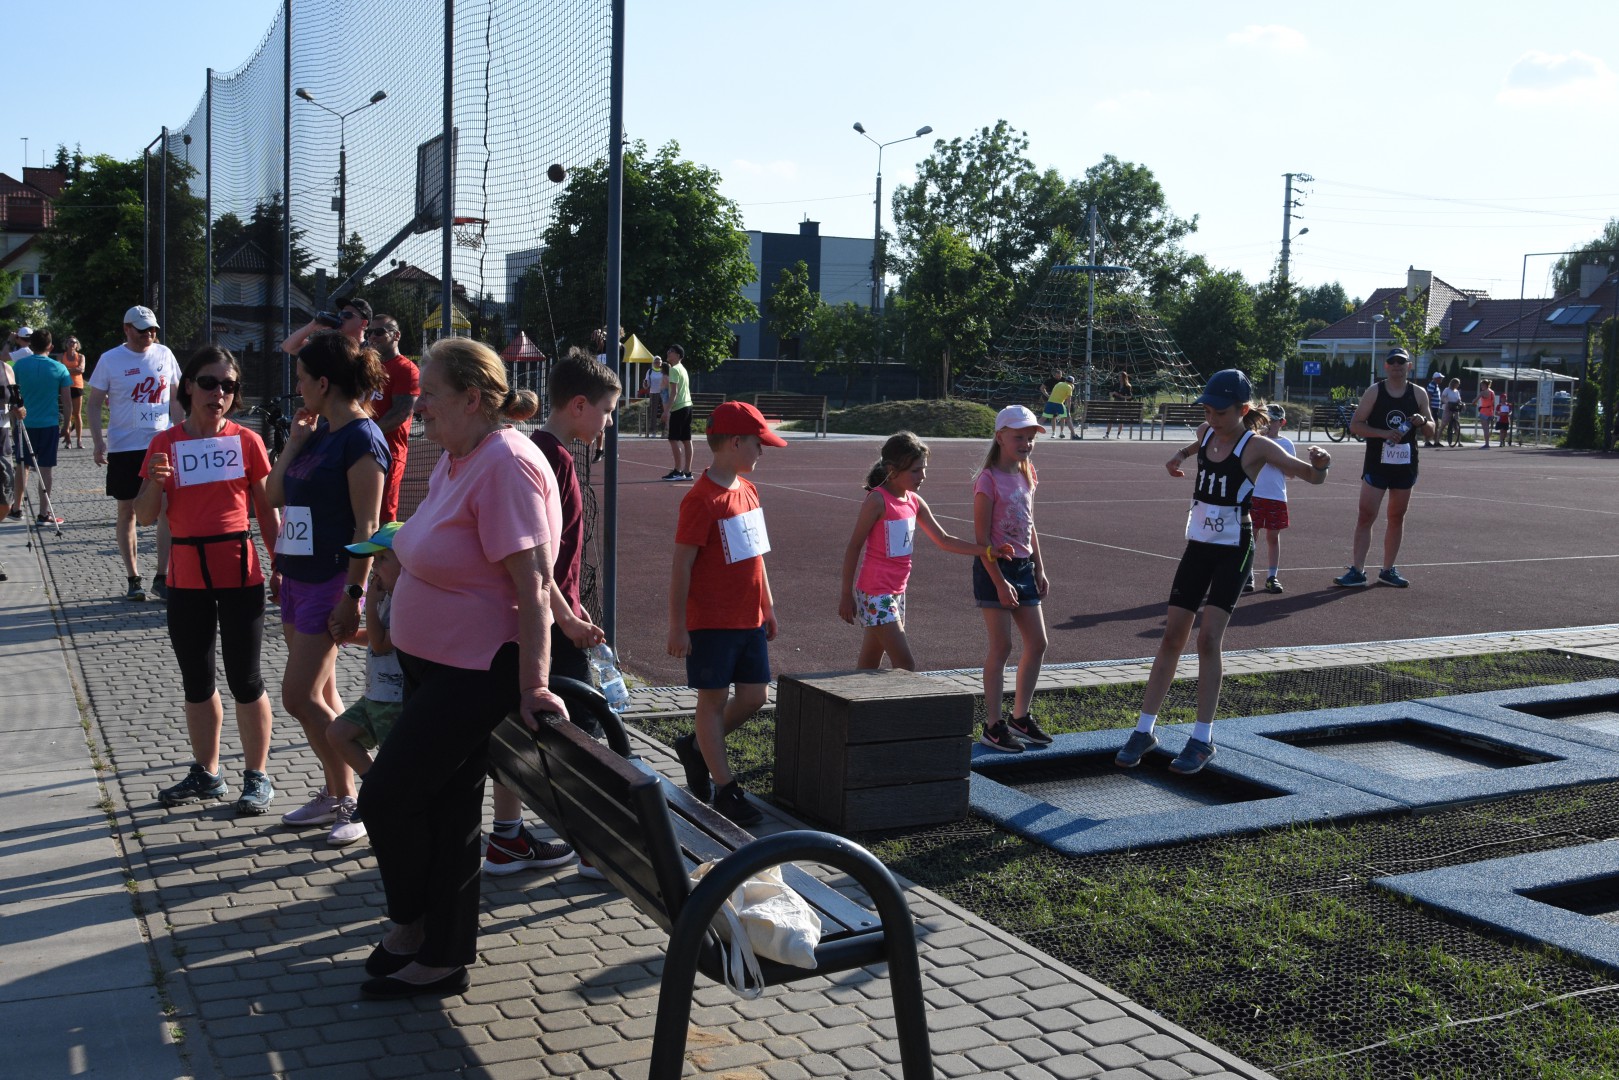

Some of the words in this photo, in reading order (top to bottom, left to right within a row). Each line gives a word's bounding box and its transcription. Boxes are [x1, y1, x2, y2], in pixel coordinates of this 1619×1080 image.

[182, 449, 239, 473] D152
[1386, 450, 1409, 459] W102
[1198, 469, 1227, 498] 111
[1203, 516, 1224, 533] A8
